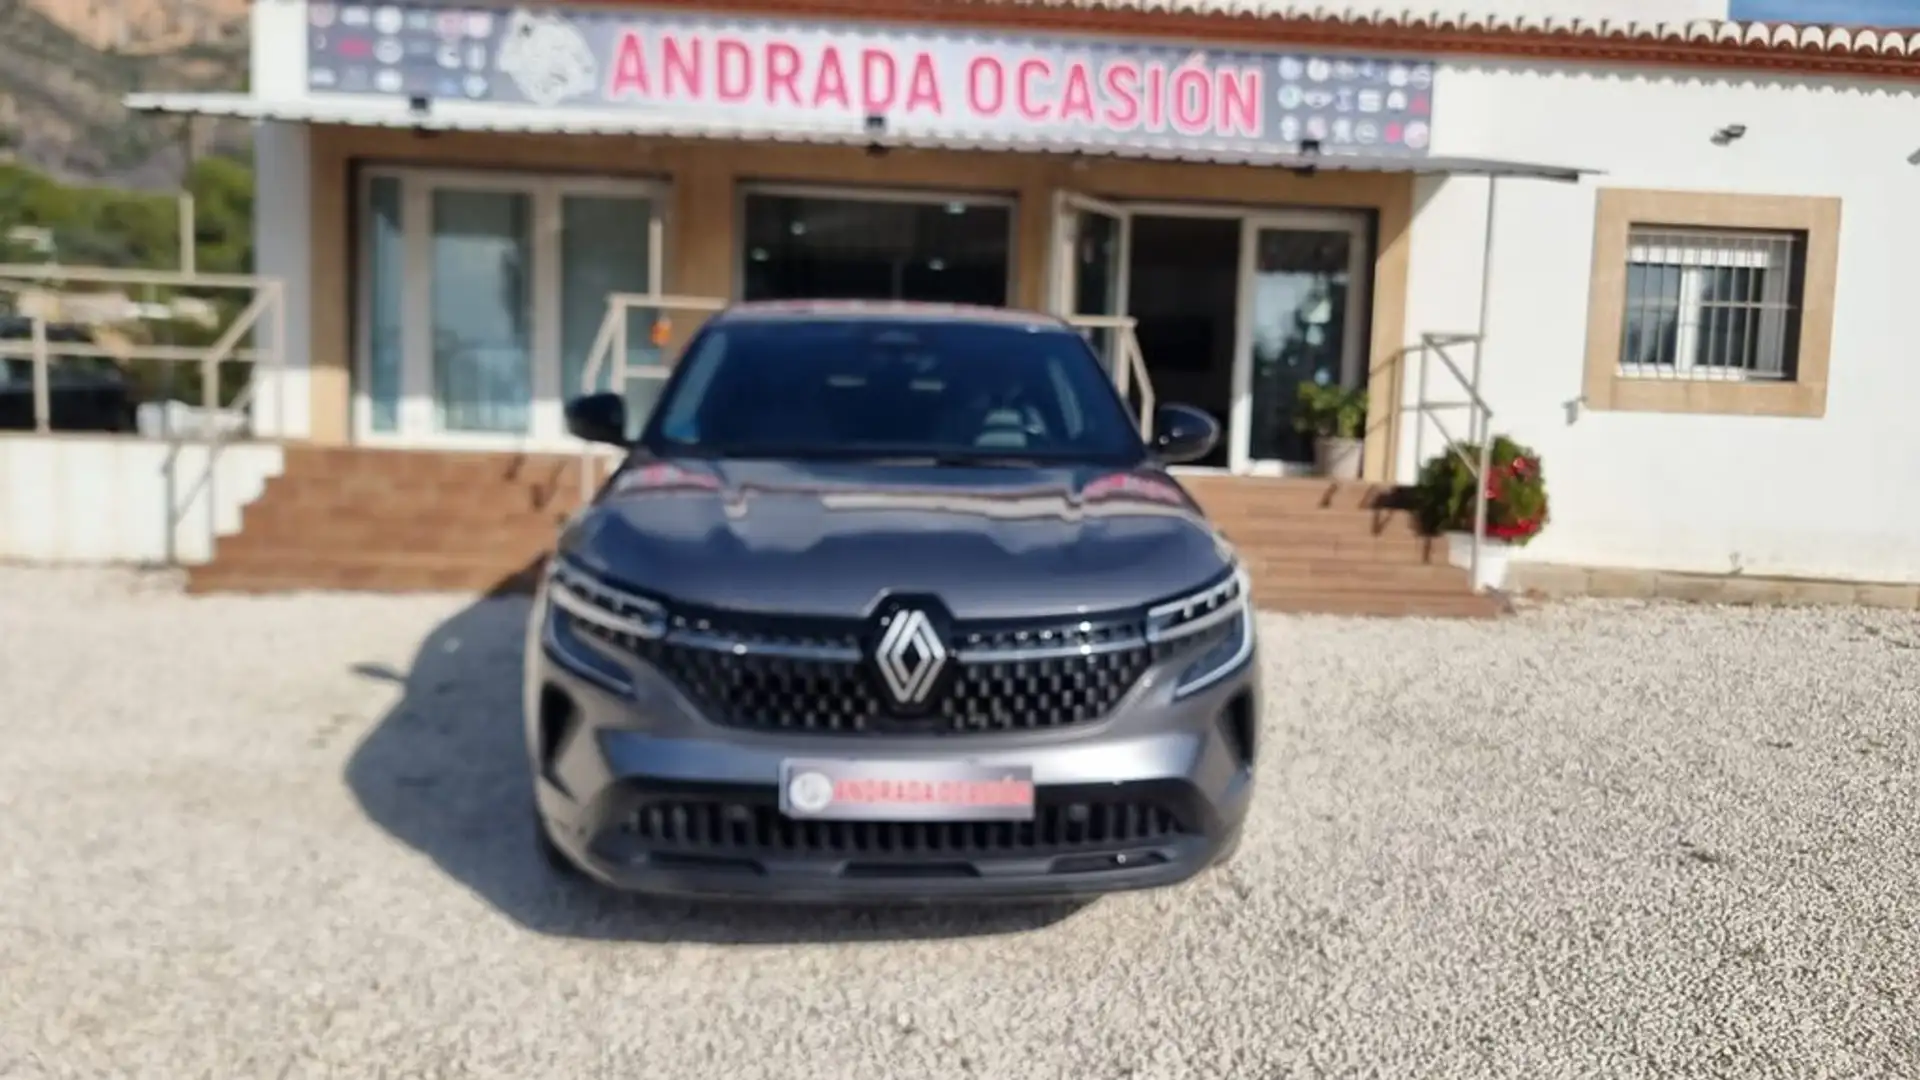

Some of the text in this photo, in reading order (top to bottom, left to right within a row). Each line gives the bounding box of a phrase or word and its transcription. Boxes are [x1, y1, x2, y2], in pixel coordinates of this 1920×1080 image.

[611, 31, 1261, 134] ANDRADA OCASIÓN
[833, 779, 935, 803] ANDRADA
